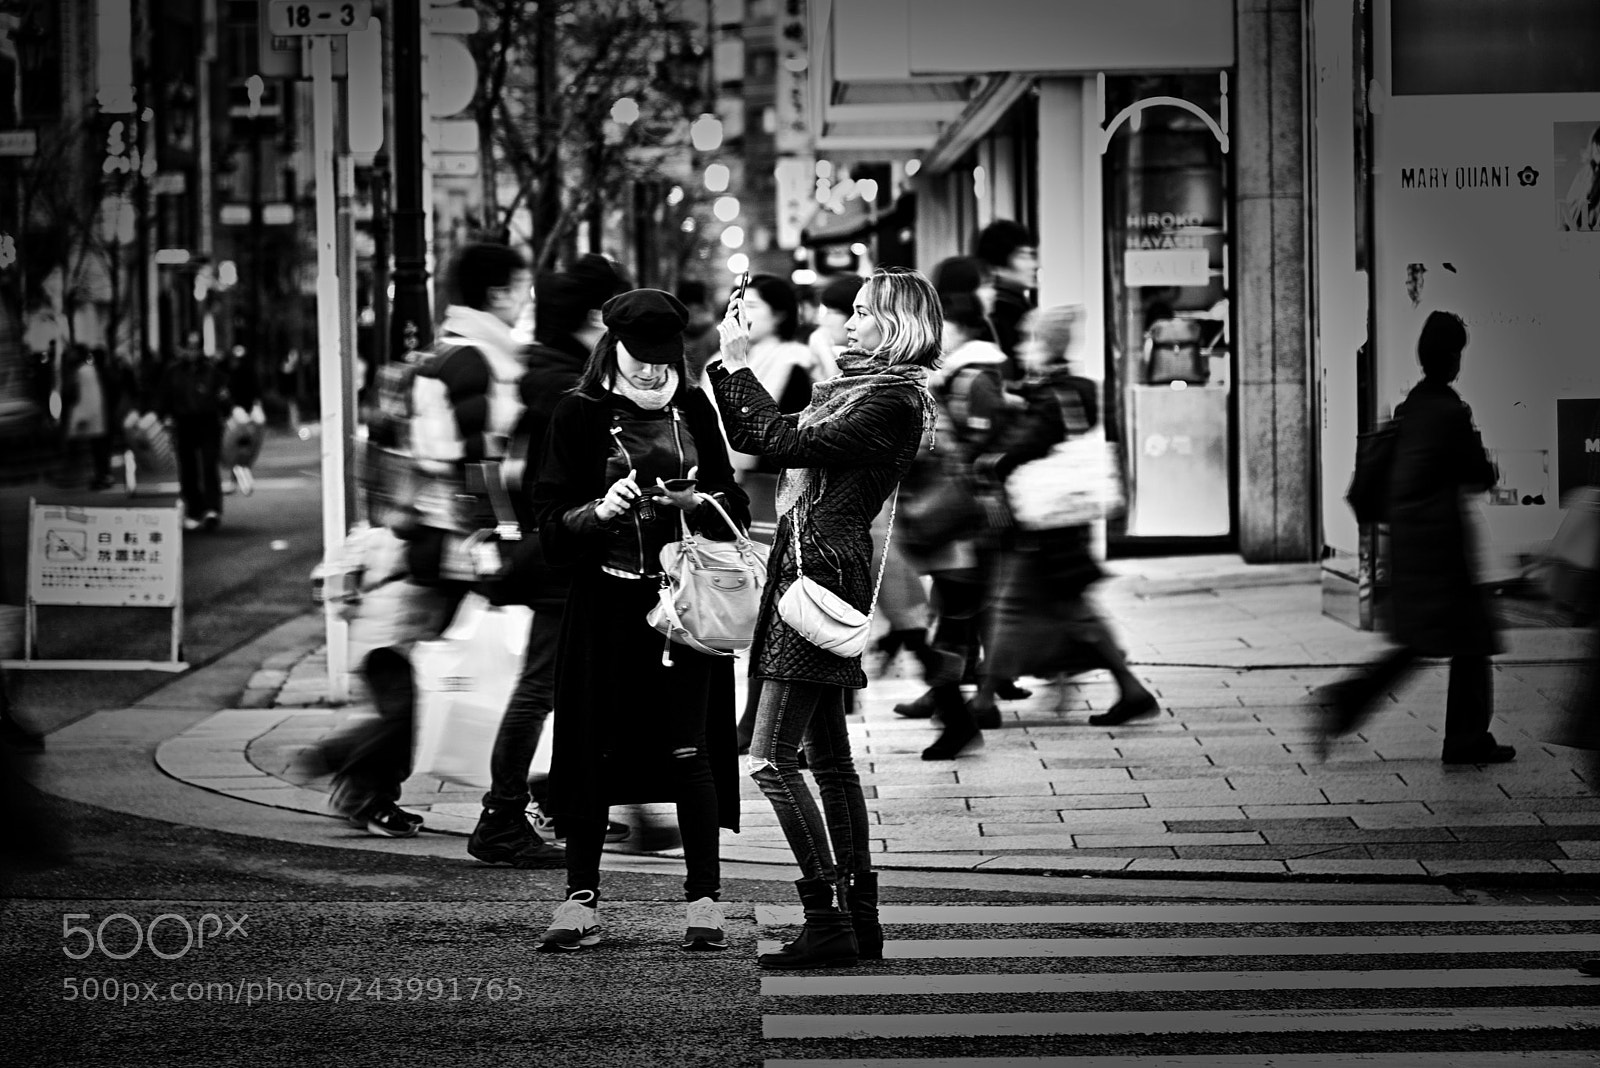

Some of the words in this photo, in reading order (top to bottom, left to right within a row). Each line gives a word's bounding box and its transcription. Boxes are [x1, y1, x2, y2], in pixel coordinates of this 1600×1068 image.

[1401, 168, 1449, 188] MARY
[1455, 166, 1510, 190] QUANT
[1126, 212, 1204, 229] HIROKO
